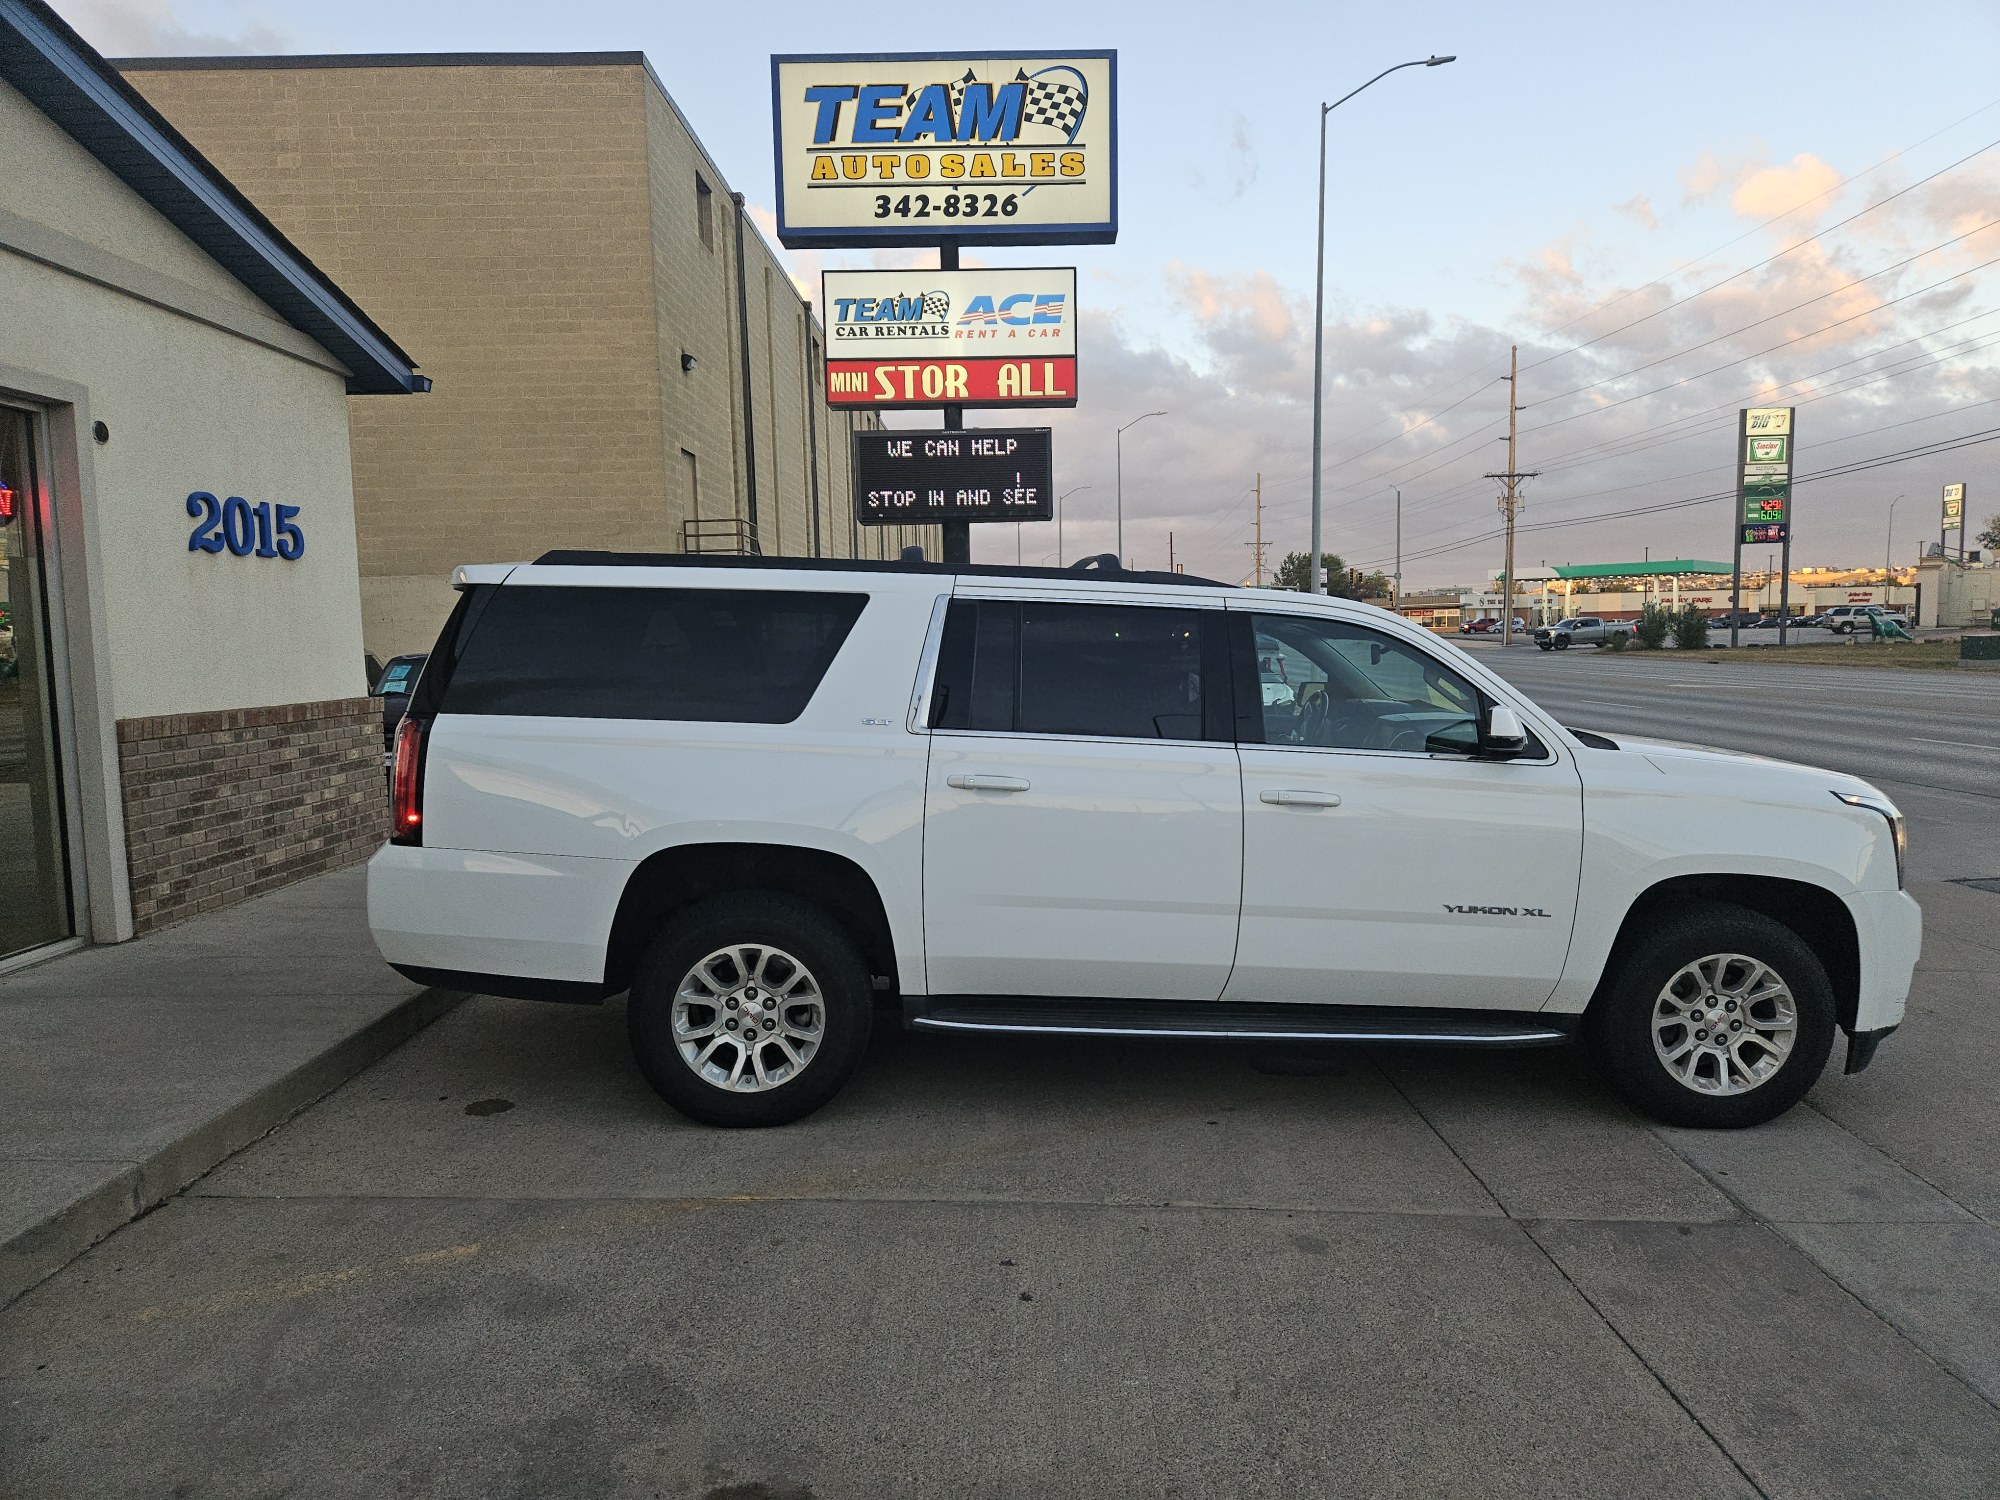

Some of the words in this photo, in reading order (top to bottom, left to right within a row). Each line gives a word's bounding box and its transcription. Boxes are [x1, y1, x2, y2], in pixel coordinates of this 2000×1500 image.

[804, 82, 1029, 144] TEAM
[811, 154, 931, 180] AUTO
[940, 152, 1086, 178] SALES
[874, 194, 1018, 218] 342-8326
[834, 297, 925, 322] TEAM
[955, 293, 1066, 325] ACE
[836, 326, 869, 337] CAR
[875, 325, 949, 336] RENTALS
[955, 329, 998, 339] RENT
[1008, 329, 1016, 338] A
[1028, 328, 1061, 338] CAR
[830, 371, 868, 392] MINI
[874, 364, 969, 400] STOR
[997, 362, 1066, 397] ALL
[887, 440, 913, 457] WE
[925, 439, 959, 456] CAN
[971, 439, 1017, 455] HELP
[868, 490, 916, 507] STOP
[928, 489, 944, 506] IN
[956, 489, 991, 506] AND
[1002, 488, 1037, 504] SEE
[186, 491, 305, 560] 2015
[1443, 904, 1517, 915] YUKON
[1521, 907, 1551, 917] XL
[743, 1006, 758, 1024] GMC
[1709, 1012, 1726, 1030] GMC
